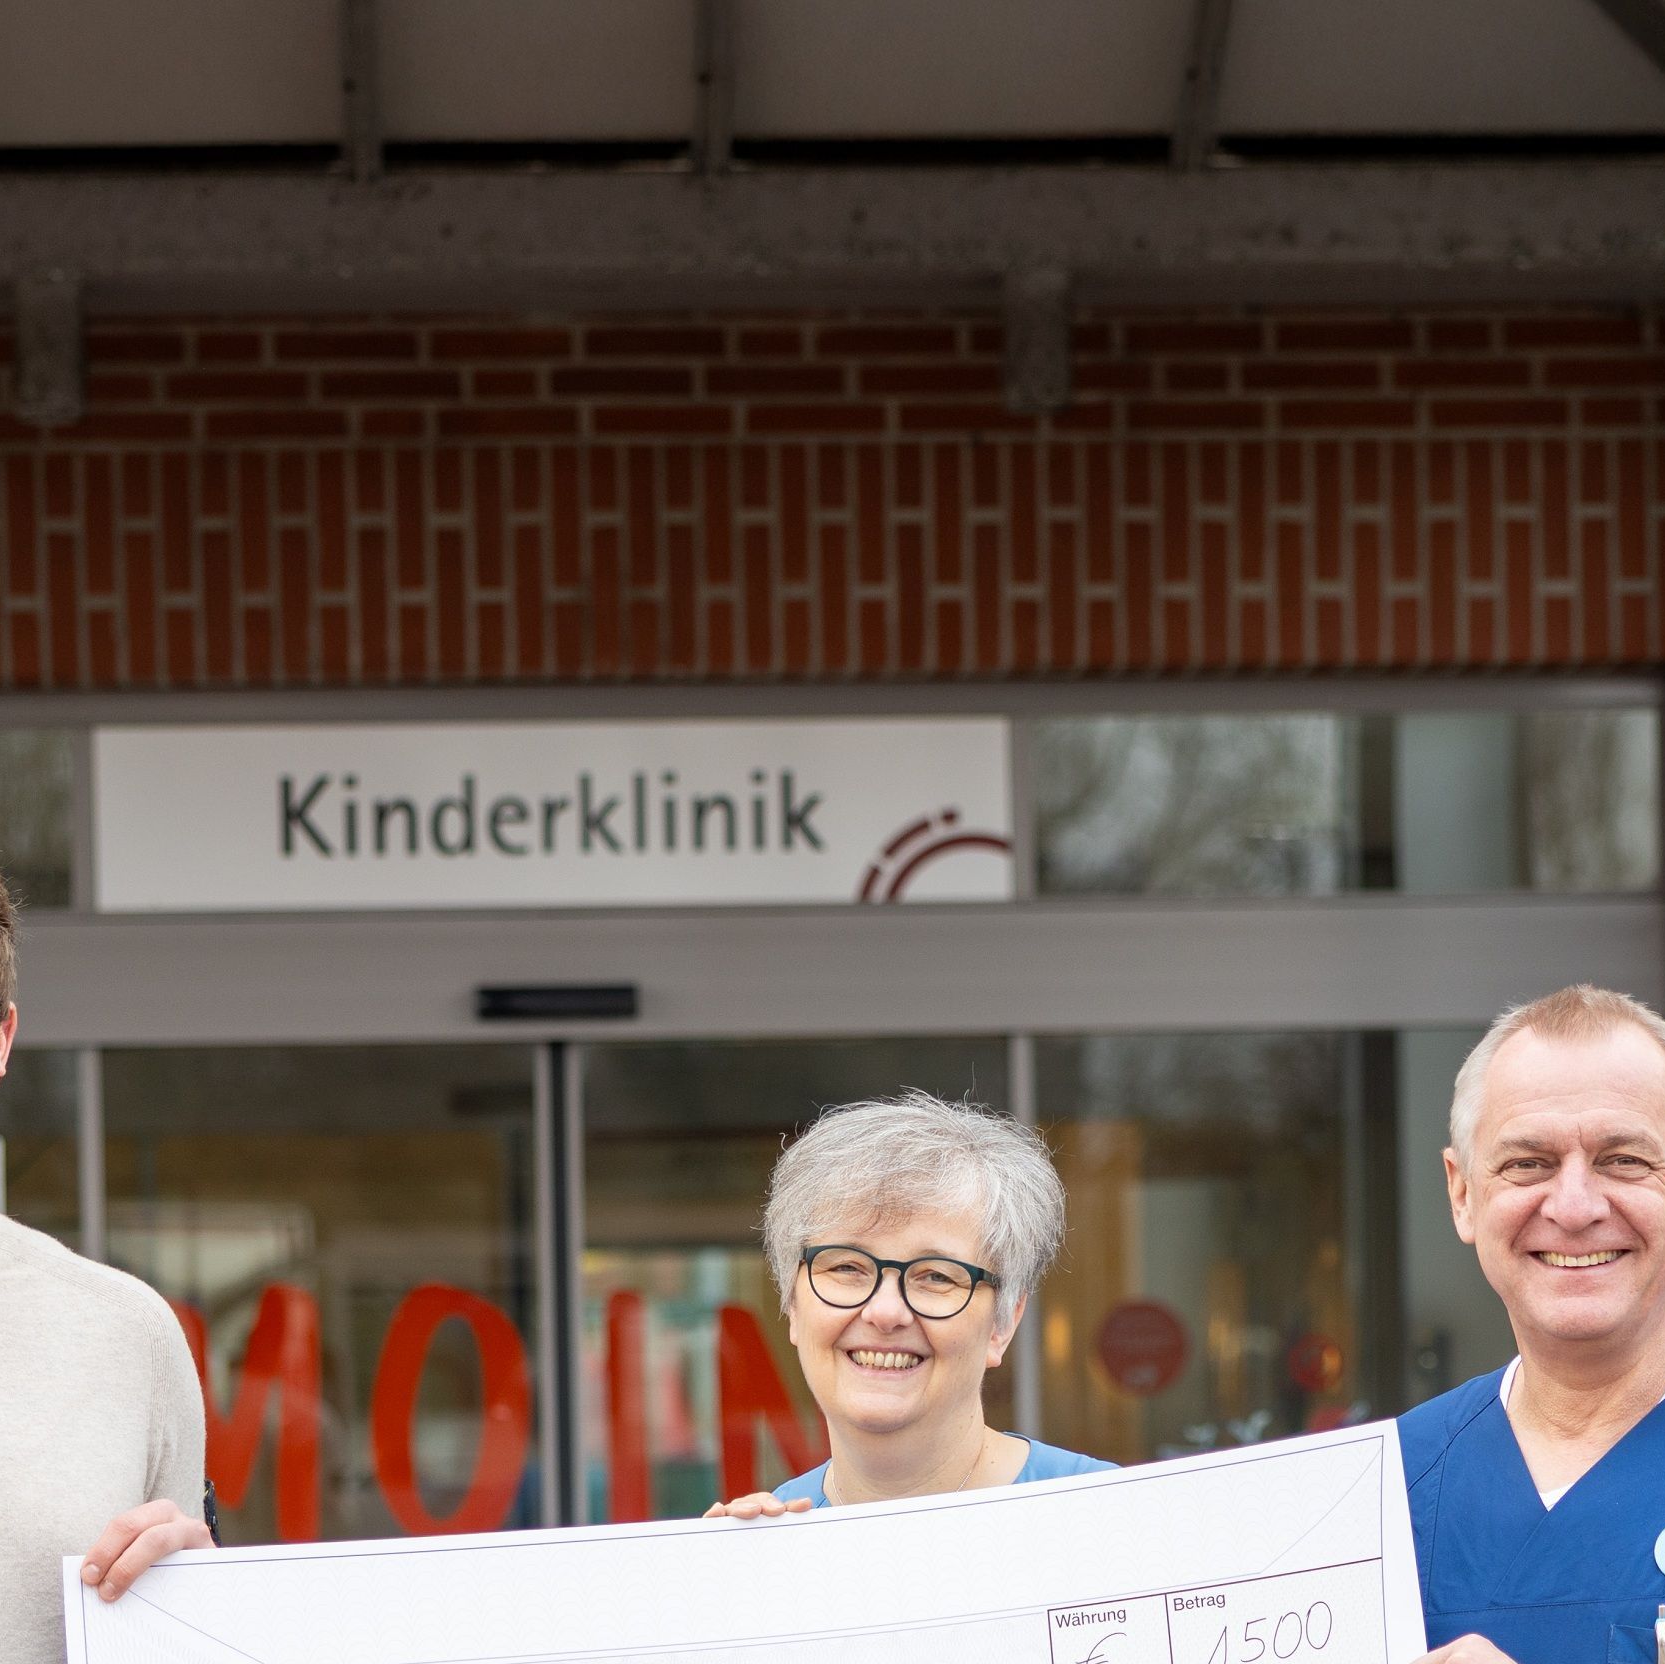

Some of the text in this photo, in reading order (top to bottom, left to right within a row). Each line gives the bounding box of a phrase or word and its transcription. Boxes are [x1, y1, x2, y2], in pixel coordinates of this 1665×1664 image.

[277, 771, 825, 858] Kinderklinik
[1173, 1593, 1226, 1612] Betrag
[1055, 1607, 1127, 1629] Währung
